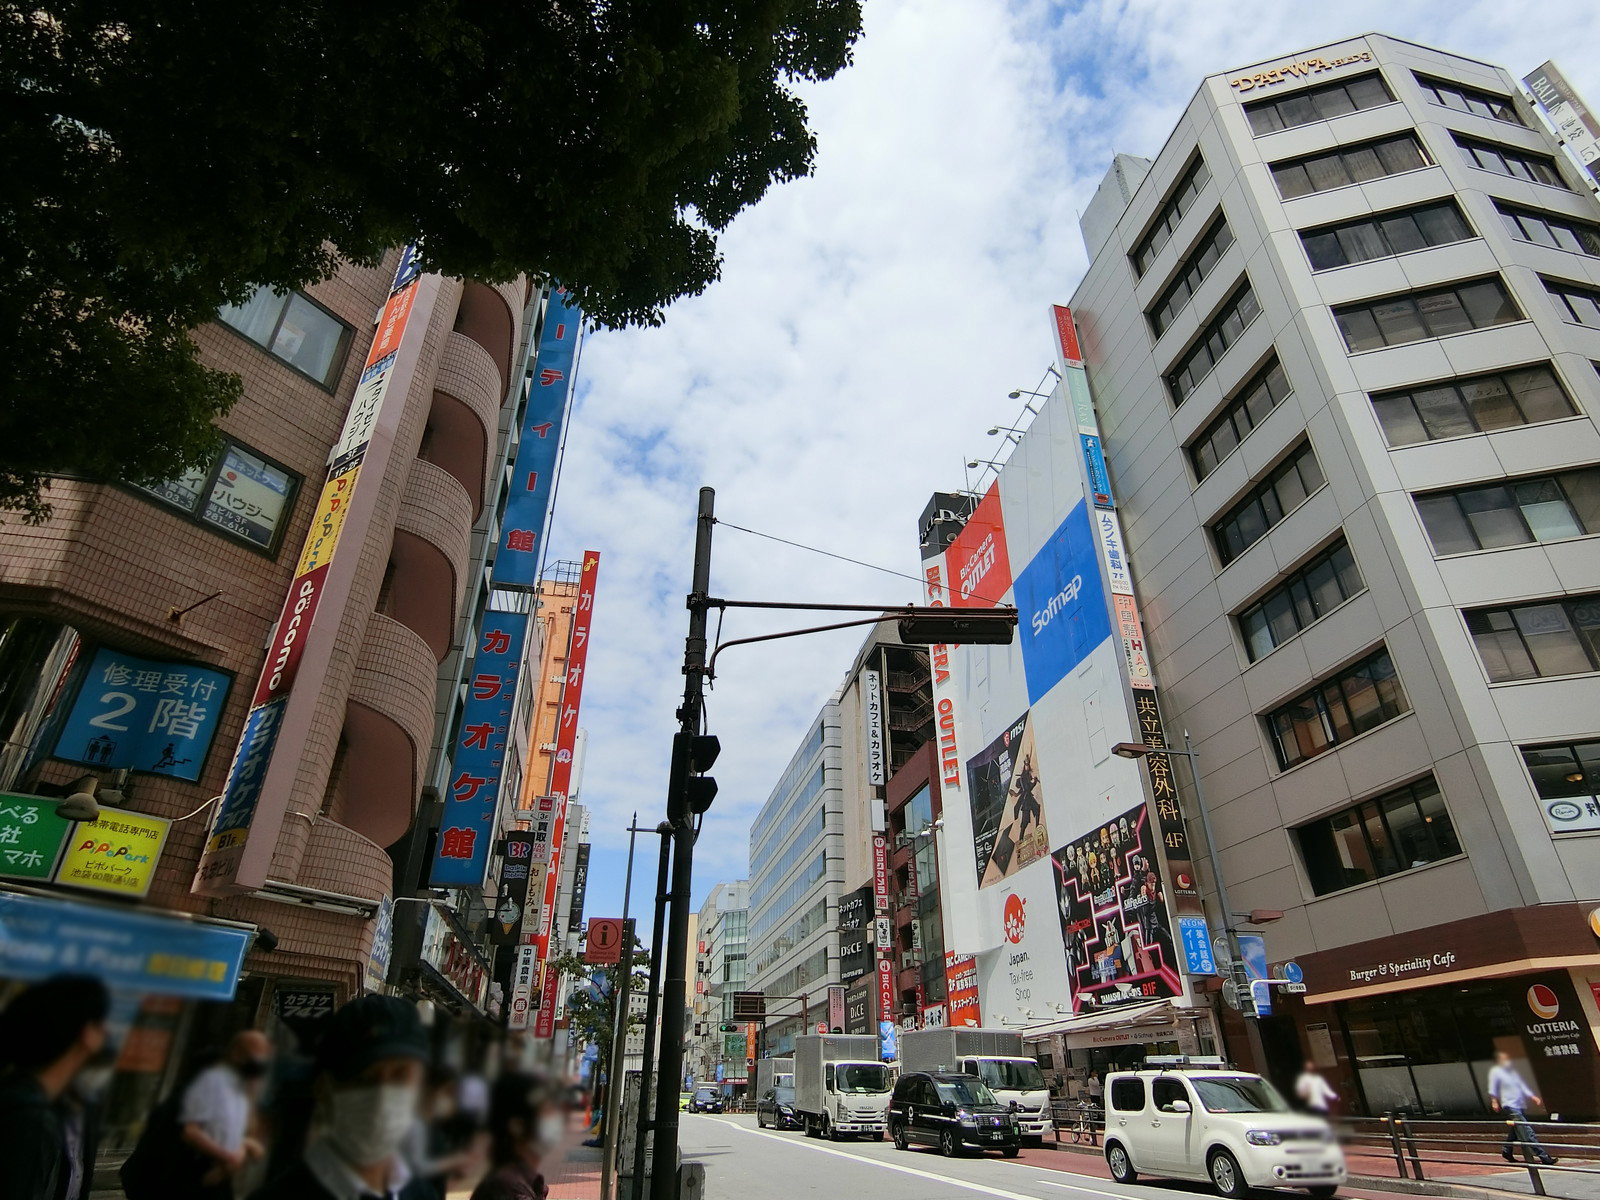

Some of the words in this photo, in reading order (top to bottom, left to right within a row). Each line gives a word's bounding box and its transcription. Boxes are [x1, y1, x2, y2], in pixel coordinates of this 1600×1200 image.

[1231, 57, 1332, 92] DAIWA
[347, 399, 368, 451] ハウジー
[346, 447, 358, 460] 3F
[205, 509, 251, 537] 981-6161
[234, 513, 248, 526] 3F
[960, 532, 993, 580] BicCamera
[961, 543, 996, 601] OUTLET
[1032, 574, 1082, 637] Sofmap
[268, 580, 314, 691] docomo
[103, 662, 218, 701] 修理受付
[926, 565, 942, 598] BIC
[938, 698, 961, 787] OUTLET
[869, 673, 882, 782] ネットカフェ&カラオケ
[440, 628, 511, 860] カラオケ館
[231, 705, 279, 809] カラオケ
[1137, 696, 1179, 821] 共立美容外科
[87, 820, 160, 840] 携帯電話専門店
[217, 832, 236, 849] B1F
[536, 821, 549, 842] 買取
[1165, 832, 1184, 848] 4F
[508, 841, 531, 858] BR
[525, 867, 540, 907] おしもみ
[1174, 888, 1197, 896] LOTTERIA
[838, 898, 863, 913] ネットカフェ
[1181, 919, 1205, 928] AEON
[1185, 928, 1200, 971] イーオン
[1195, 928, 1209, 959] 英会話
[1009, 969, 1034, 985] Tax-free
[1349, 968, 1378, 982] Burger
[1378, 964, 1388, 975] &
[1389, 957, 1431, 977] Speciality
[1433, 951, 1456, 968] Cafe
[881, 974, 889, 989] BIC
[1142, 981, 1157, 996] B1F
[284, 994, 332, 1007] カラオケ
[1015, 987, 1031, 1001] Shop
[283, 1005, 331, 1018] 747
[1526, 1020, 1580, 1035] LOTTERIA
[1544, 1043, 1580, 1057] 全席禁煙
